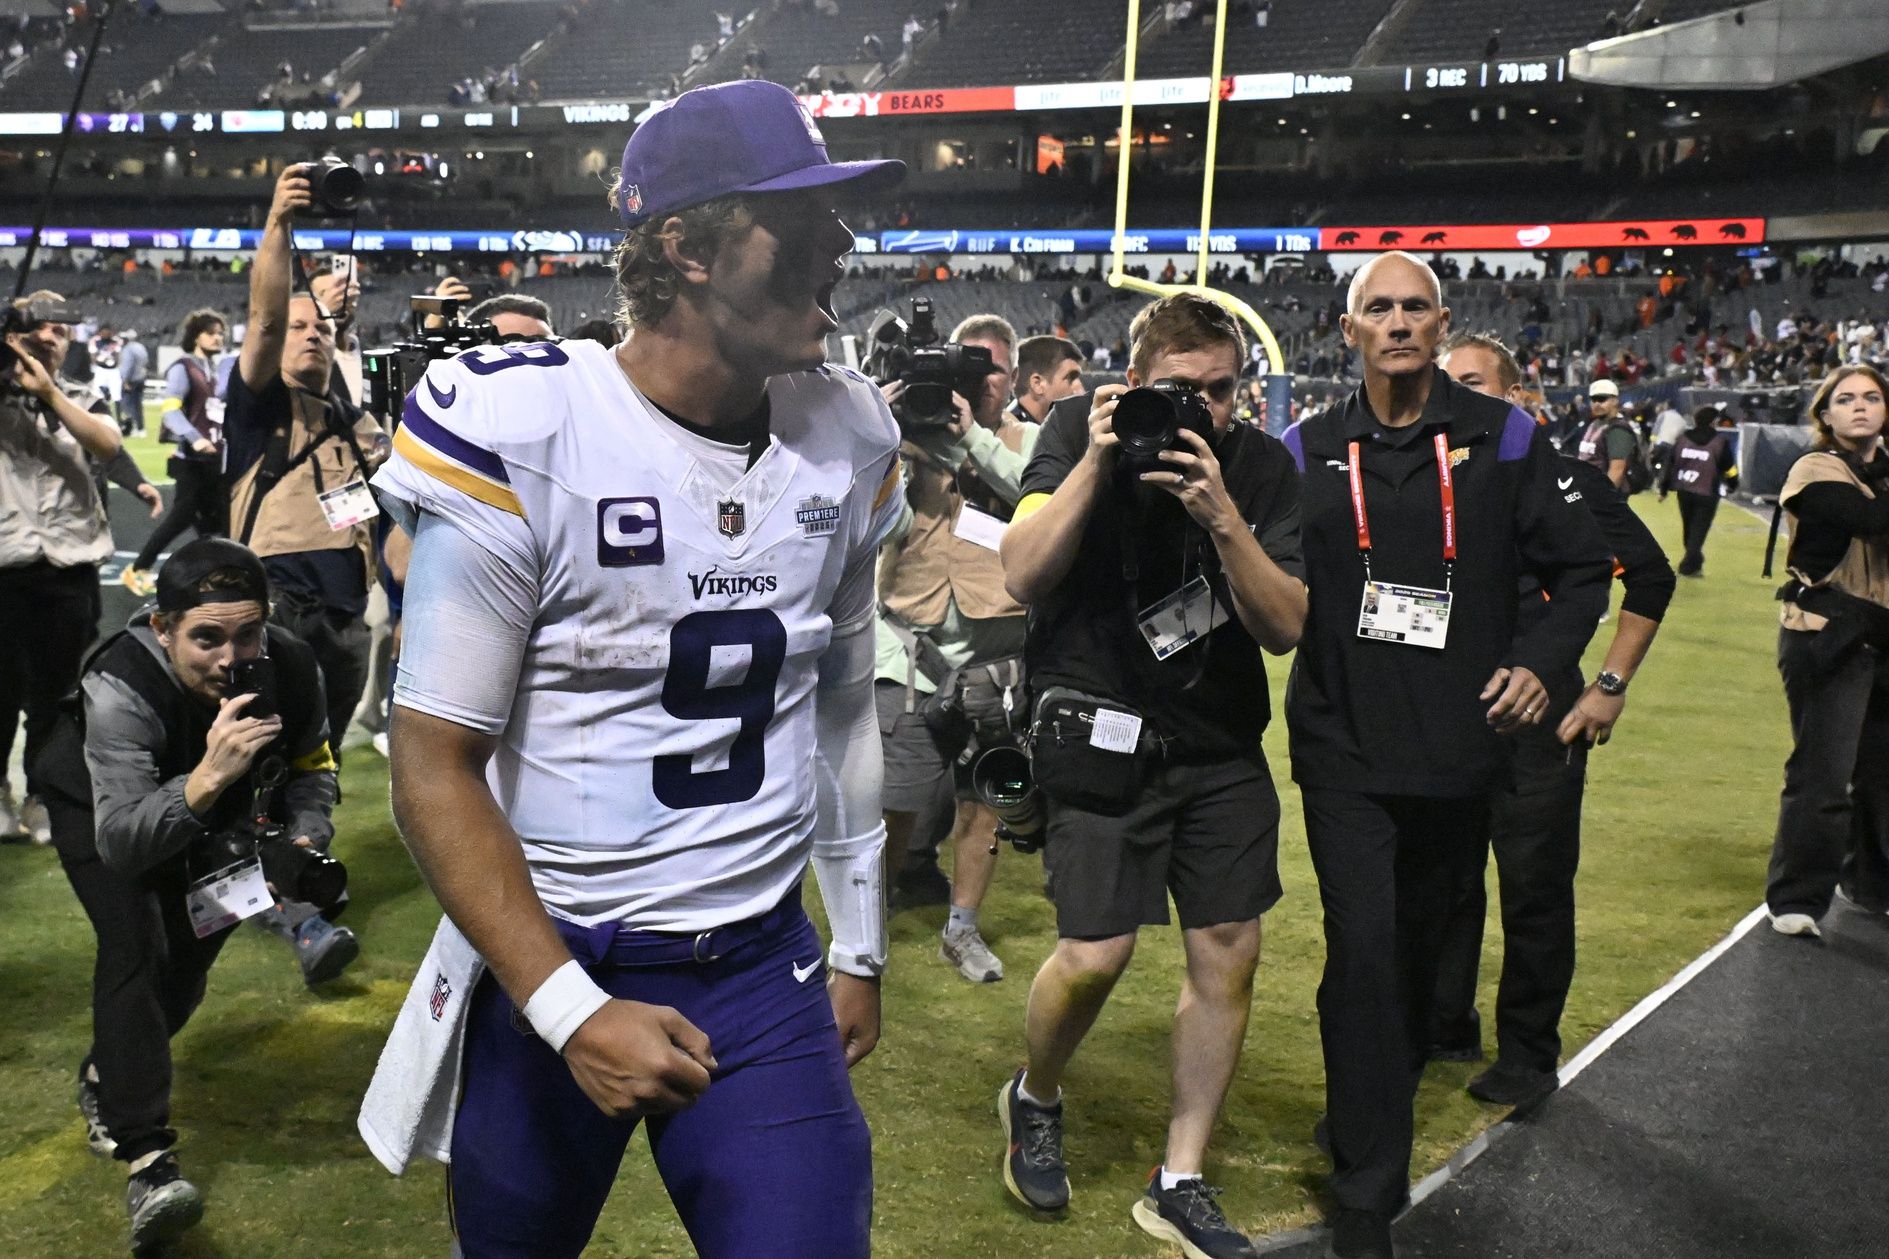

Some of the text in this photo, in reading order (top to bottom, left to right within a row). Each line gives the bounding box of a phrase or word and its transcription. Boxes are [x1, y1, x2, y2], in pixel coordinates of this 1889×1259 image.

[563, 104, 630, 123] VIKINGS
[891, 94, 945, 110] BEARS
[1440, 446, 1450, 488] SECURITY
[603, 502, 658, 548] C
[1445, 512, 1453, 548] VIKINGS
[652, 608, 787, 810] 9
